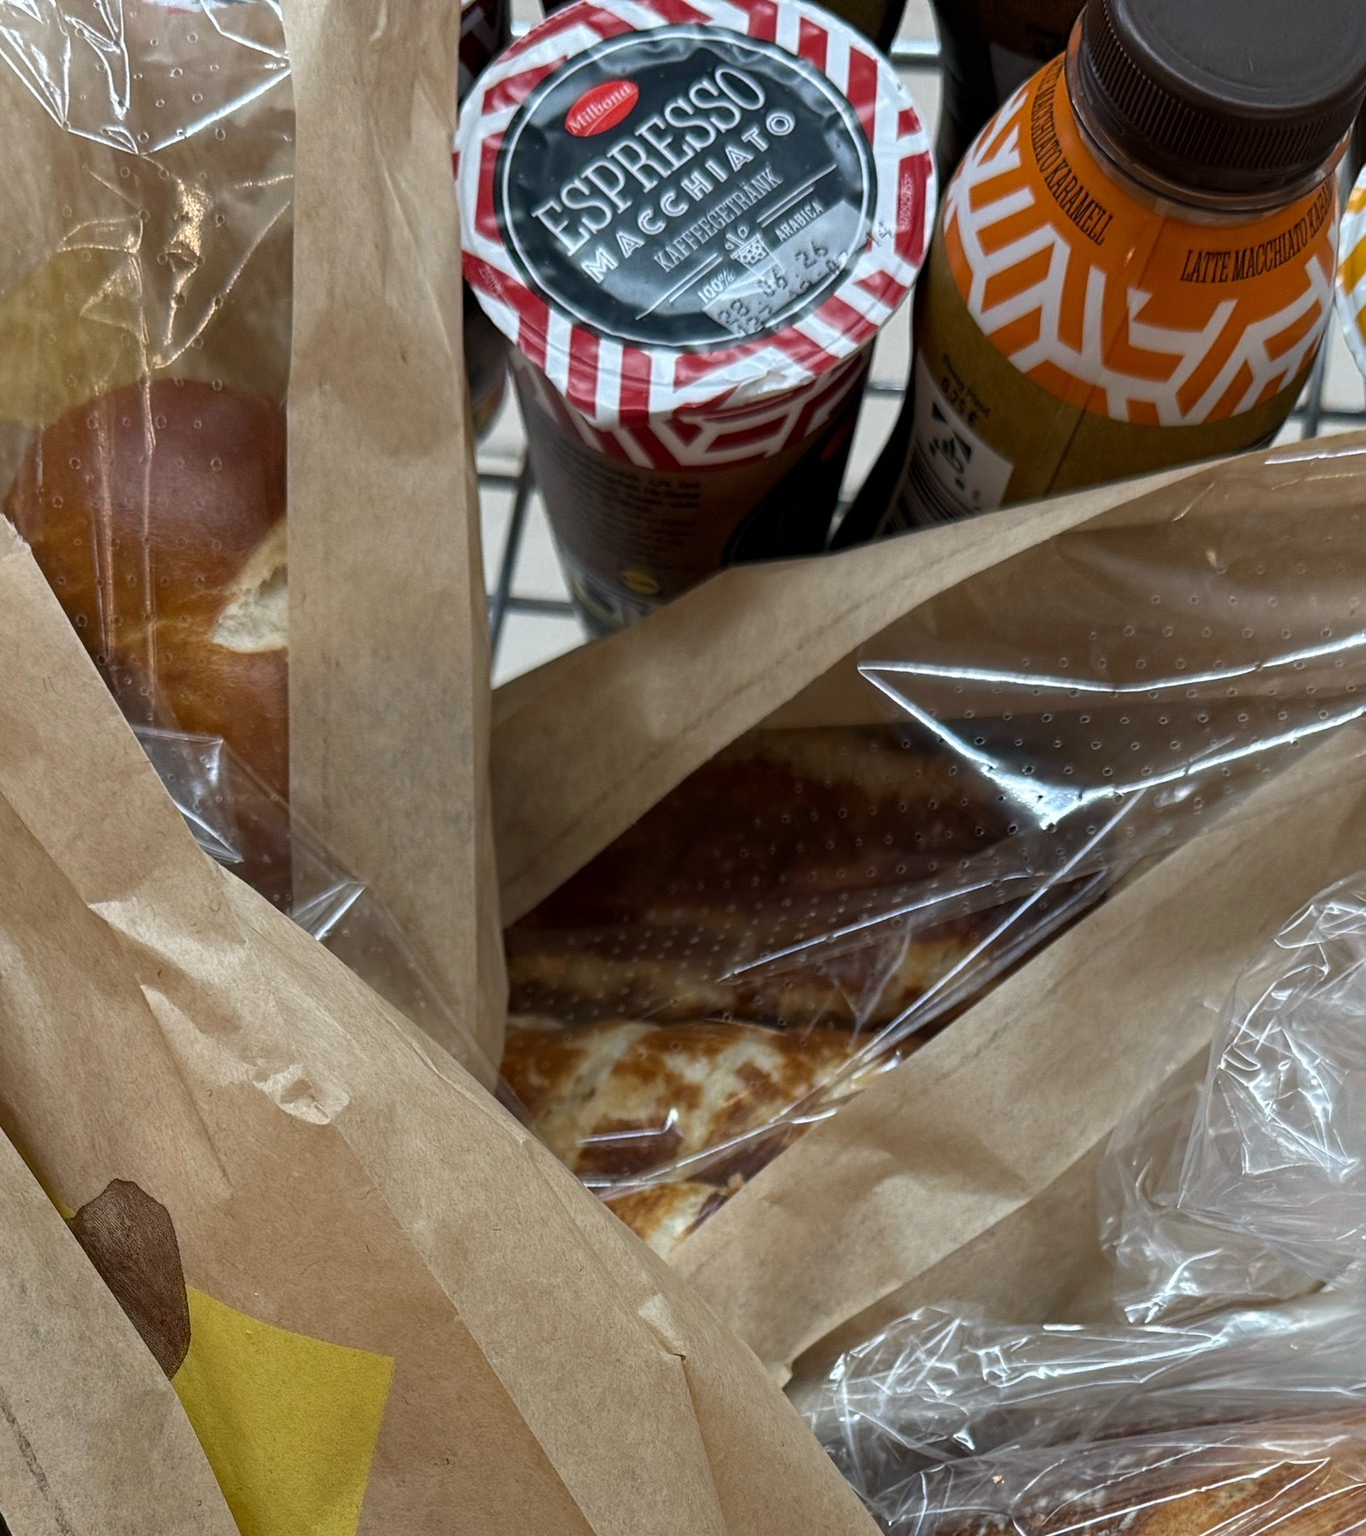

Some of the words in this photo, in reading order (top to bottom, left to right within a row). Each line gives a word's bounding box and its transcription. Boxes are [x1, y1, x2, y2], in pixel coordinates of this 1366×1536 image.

[568, 84, 633, 134] Milbona
[531, 65, 766, 257] ESPRESSO
[581, 111, 796, 284] MACCHIATO
[1043, 159, 1113, 247] KARAMELL
[653, 163, 784, 273] KAFFEEGETRÄNK
[774, 200, 826, 243] ARABICA
[1180, 248, 1233, 284] LATTE
[1232, 222, 1310, 282] MACCHIATO
